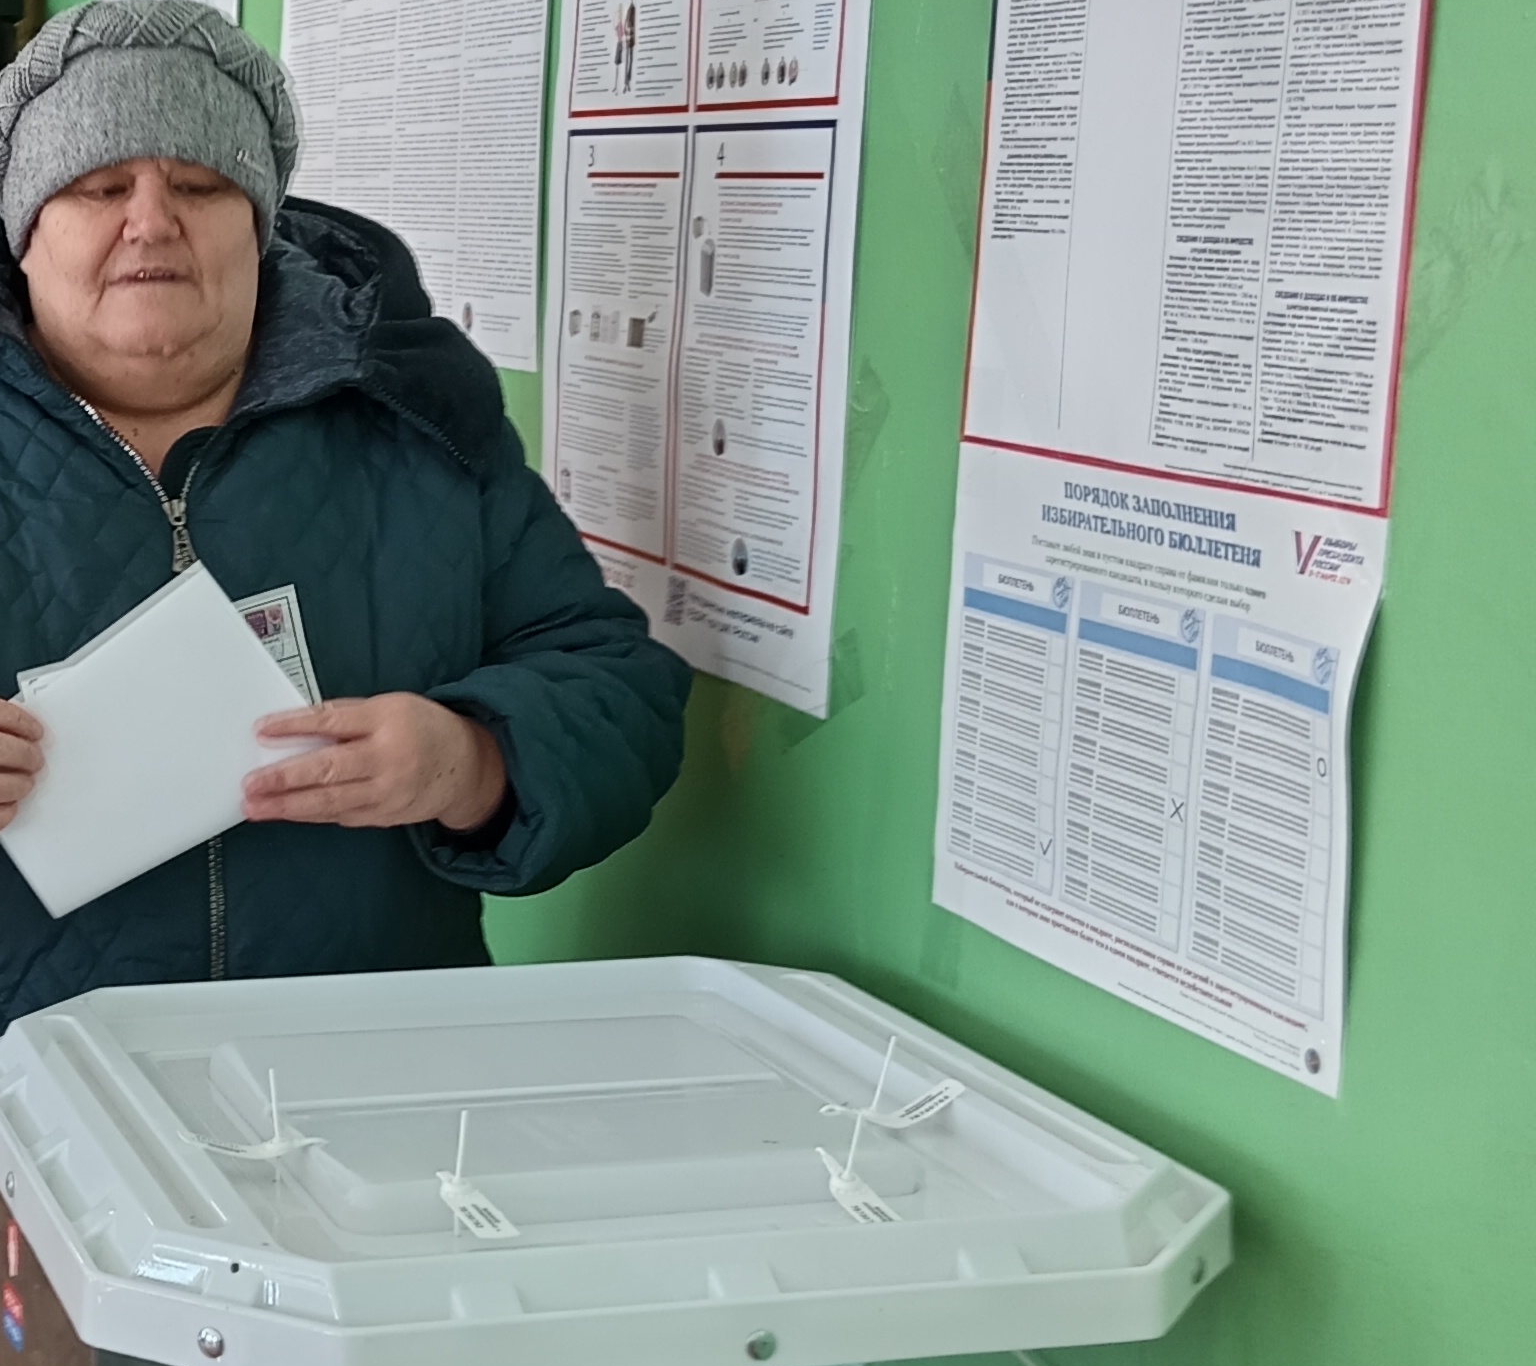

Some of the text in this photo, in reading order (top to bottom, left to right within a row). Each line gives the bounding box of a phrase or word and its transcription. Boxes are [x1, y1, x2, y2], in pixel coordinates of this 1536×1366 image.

[588, 145, 595, 167] 3
[716, 142, 725, 167] 4
[1064, 481, 1130, 511] ПОРЯДОК
[1133, 495, 1236, 532] ЗАПОЛНЕНИЯ
[1042, 504, 1262, 568] ИЗБИРАТЕЛЬНОГО БЮЛЛЕТЕНЯ
[998, 573, 1035, 592] БЮЛЛЕТЕНЬ
[1118, 604, 1160, 624] БЮЛЛЕТЕНЬ
[1255, 639, 1295, 663] БЮЛЛЕТЕНЬ
